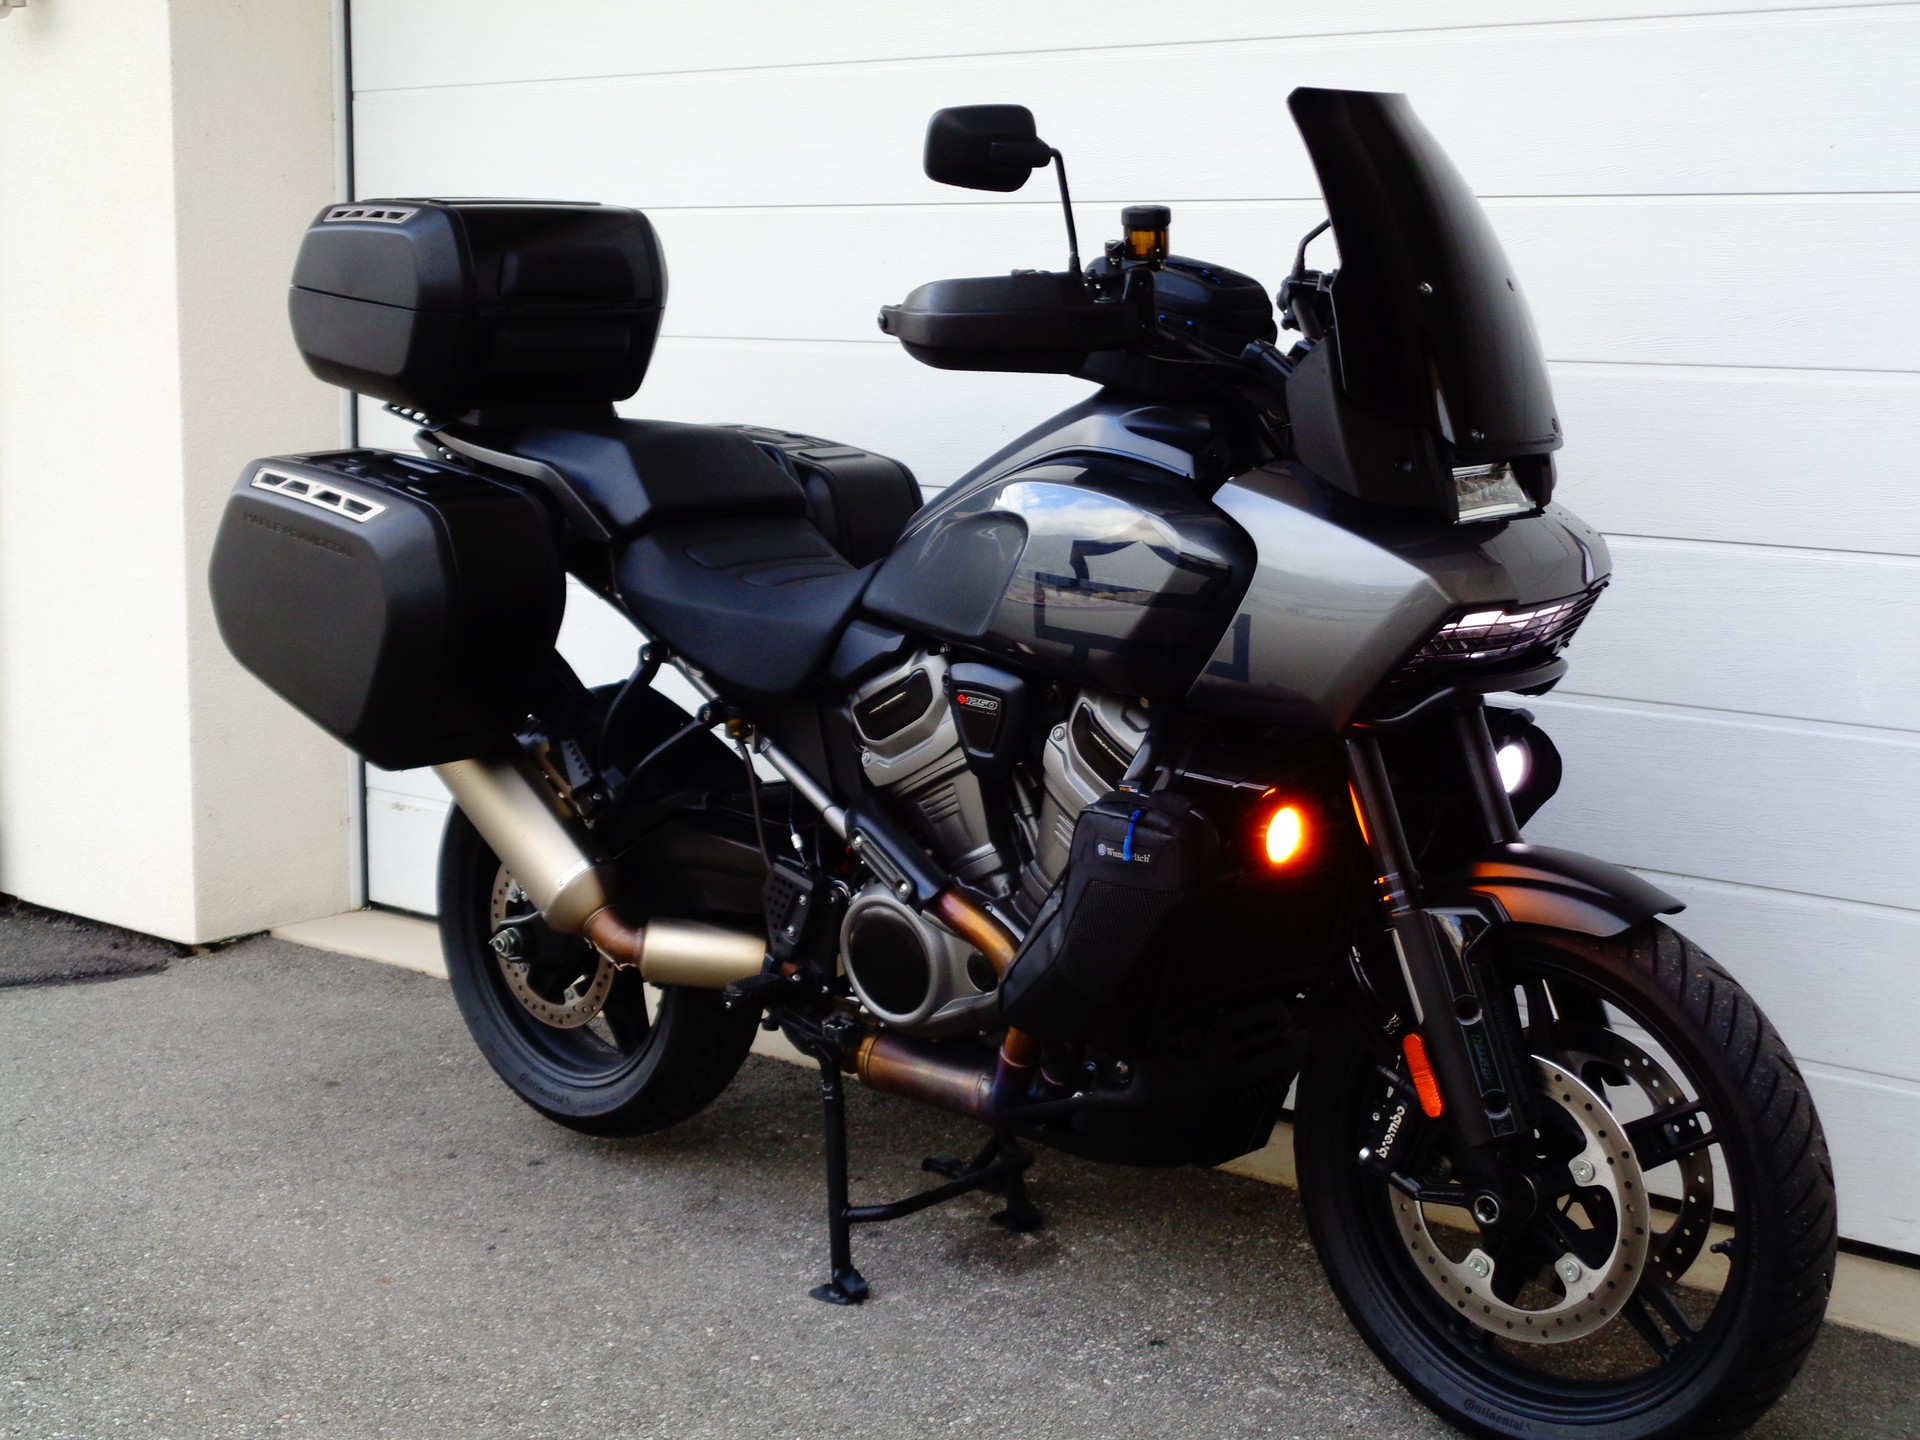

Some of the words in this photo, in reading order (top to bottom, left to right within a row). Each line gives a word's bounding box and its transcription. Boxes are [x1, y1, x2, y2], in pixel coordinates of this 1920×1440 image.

[966, 696, 999, 711] 1250
[1375, 1105, 1406, 1159] brembo
[1463, 1398, 1524, 1431] Continental
